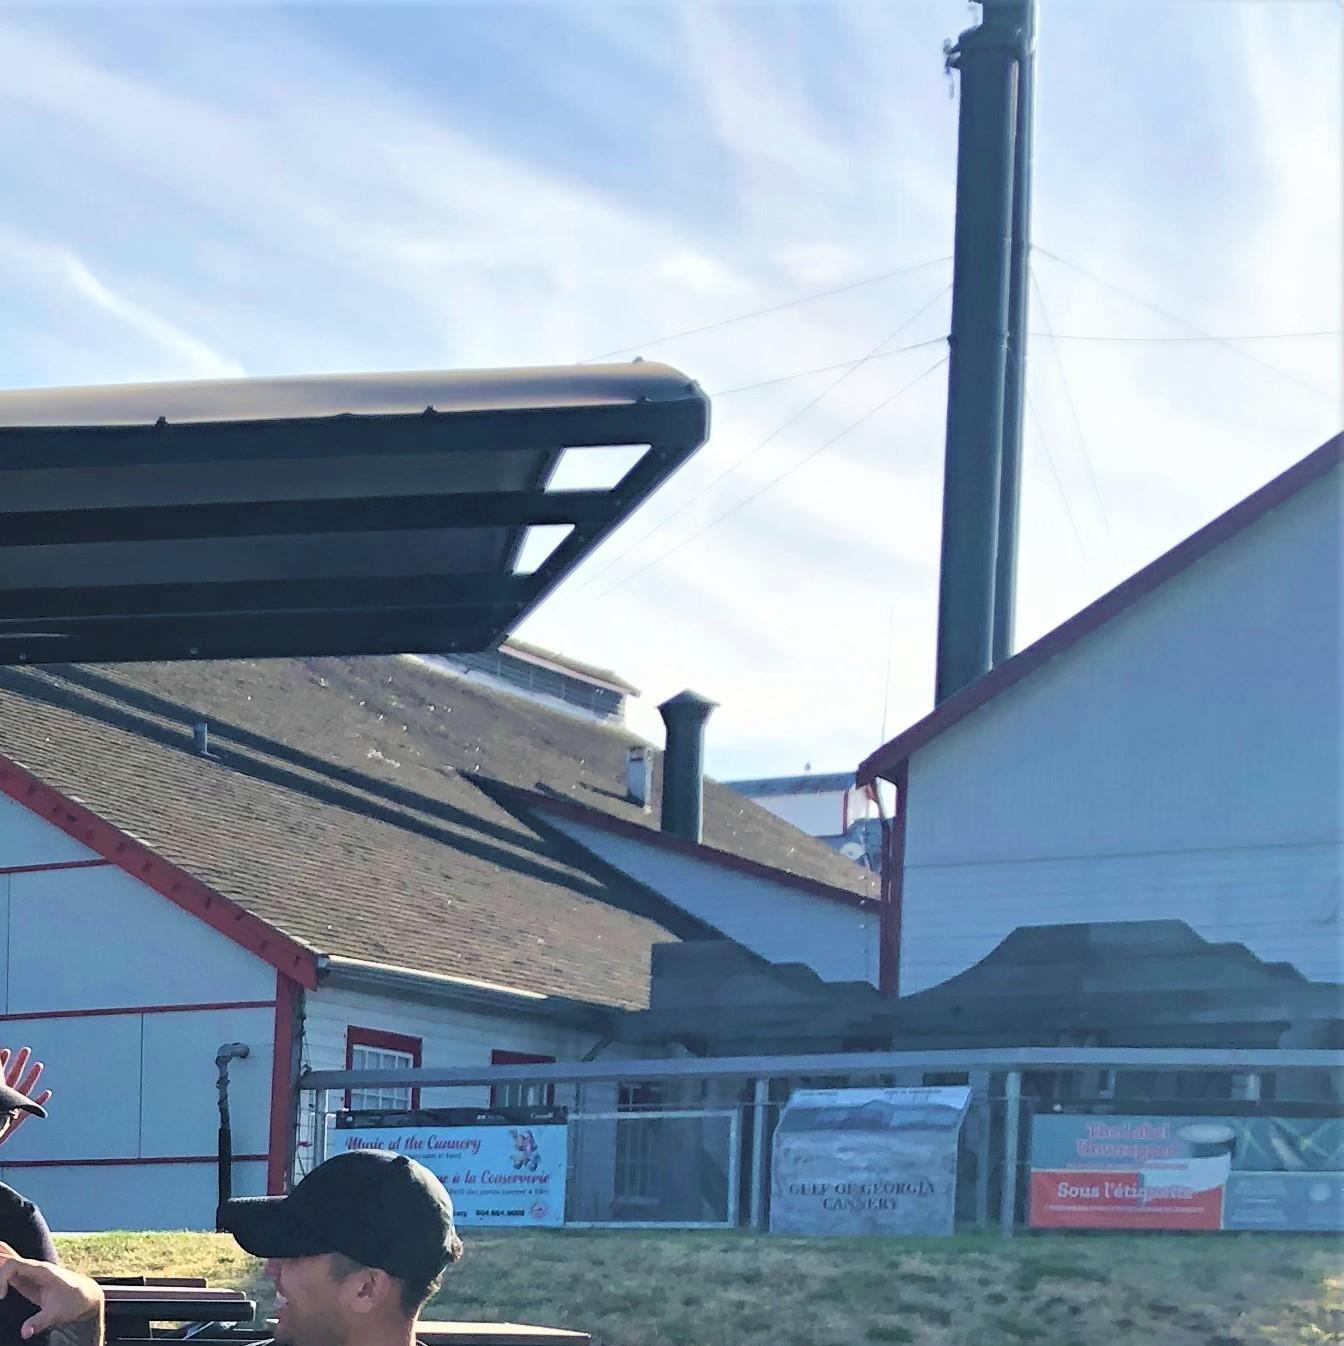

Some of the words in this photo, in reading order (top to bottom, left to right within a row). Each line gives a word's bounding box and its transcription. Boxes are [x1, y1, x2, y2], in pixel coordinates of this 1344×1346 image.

[345, 1136, 384, 1150] Music
[388, 1136, 402, 1150] at
[404, 1135, 422, 1149] the
[427, 1134, 481, 1155] Cannery
[862, 1180, 935, 1196] GEORGIA
[1058, 1181, 1099, 1198] Sous
[823, 1198, 897, 1210] CANNERY
